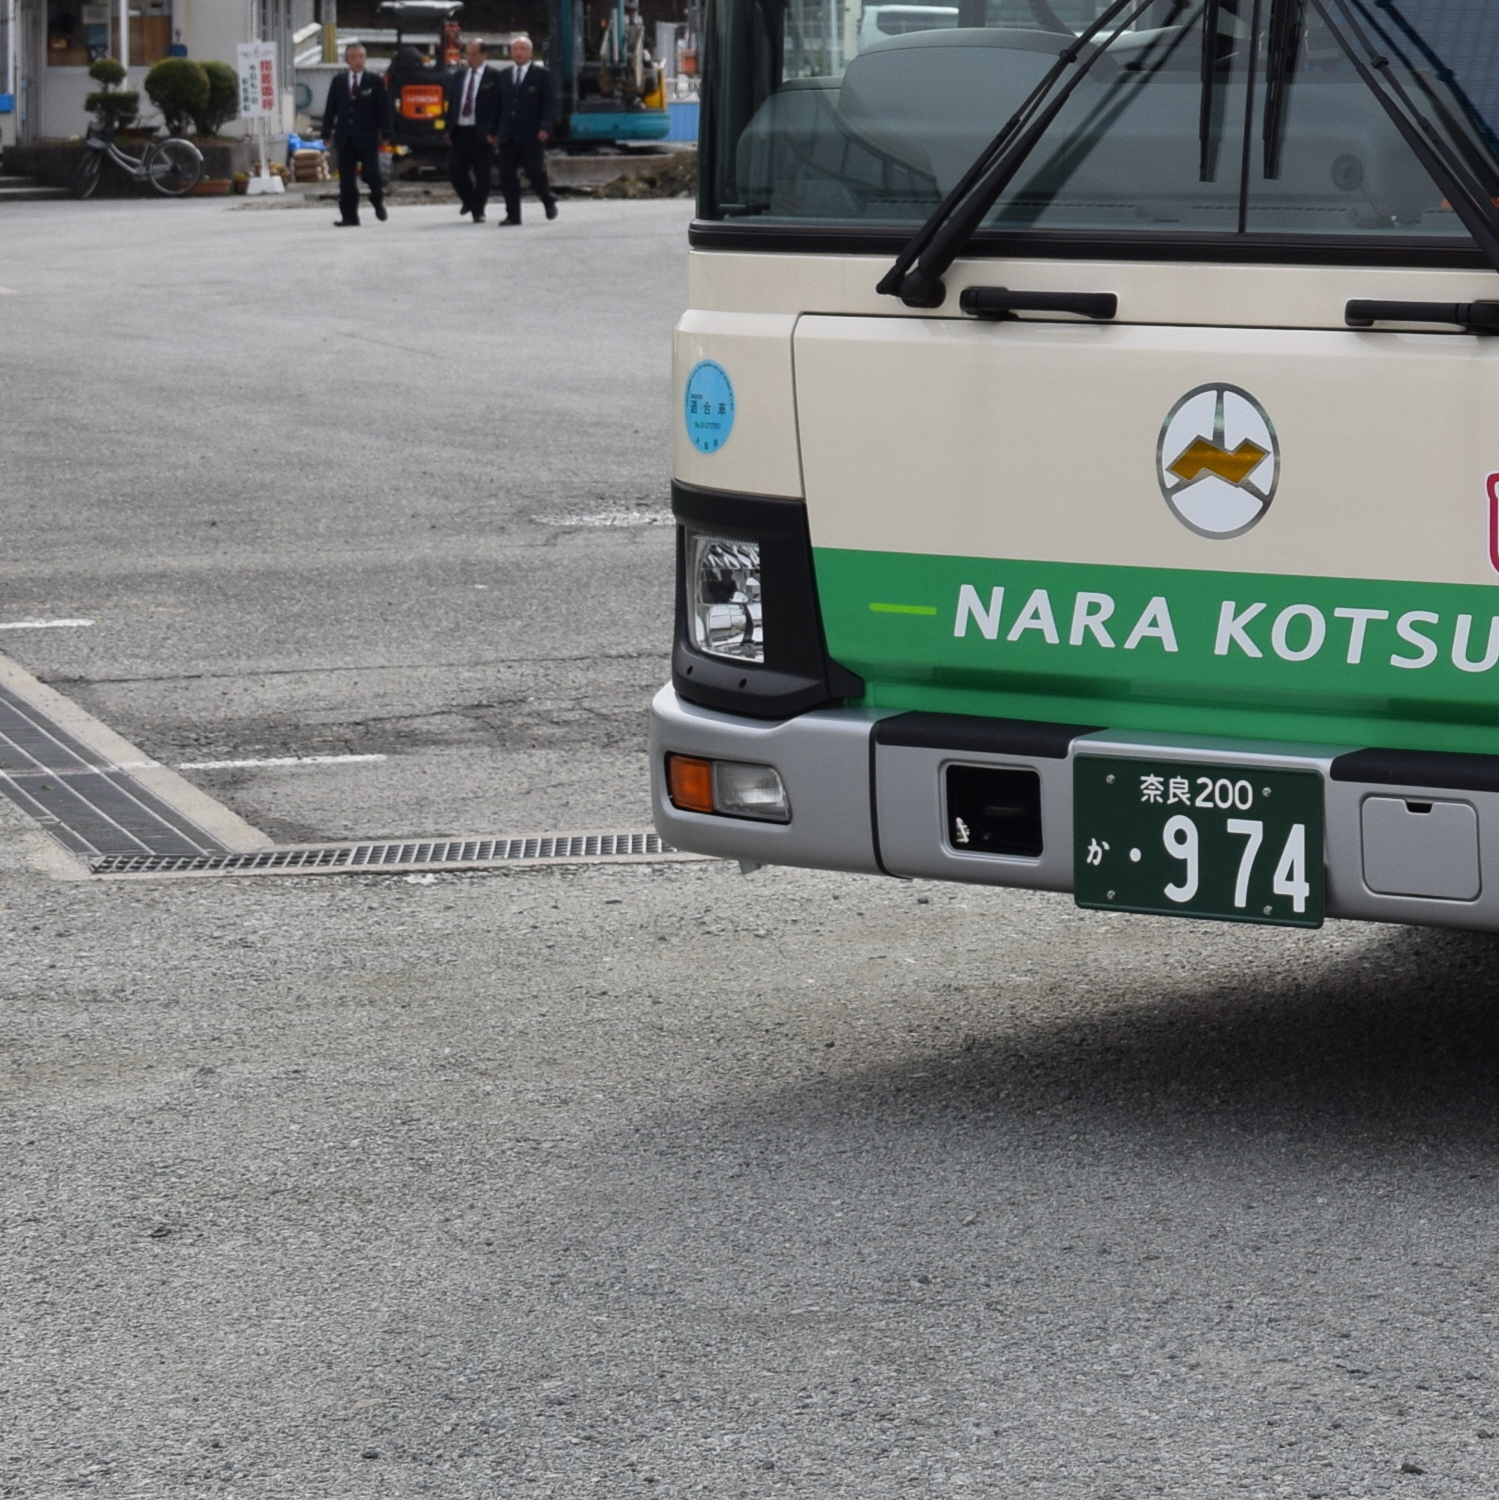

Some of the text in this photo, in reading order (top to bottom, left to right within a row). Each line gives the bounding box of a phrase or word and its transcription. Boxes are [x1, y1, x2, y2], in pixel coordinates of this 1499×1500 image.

[953, 584, 1179, 652] NARA
[1140, 773, 1253, 810] 奈良200
[1086, 837, 1110, 866] か
